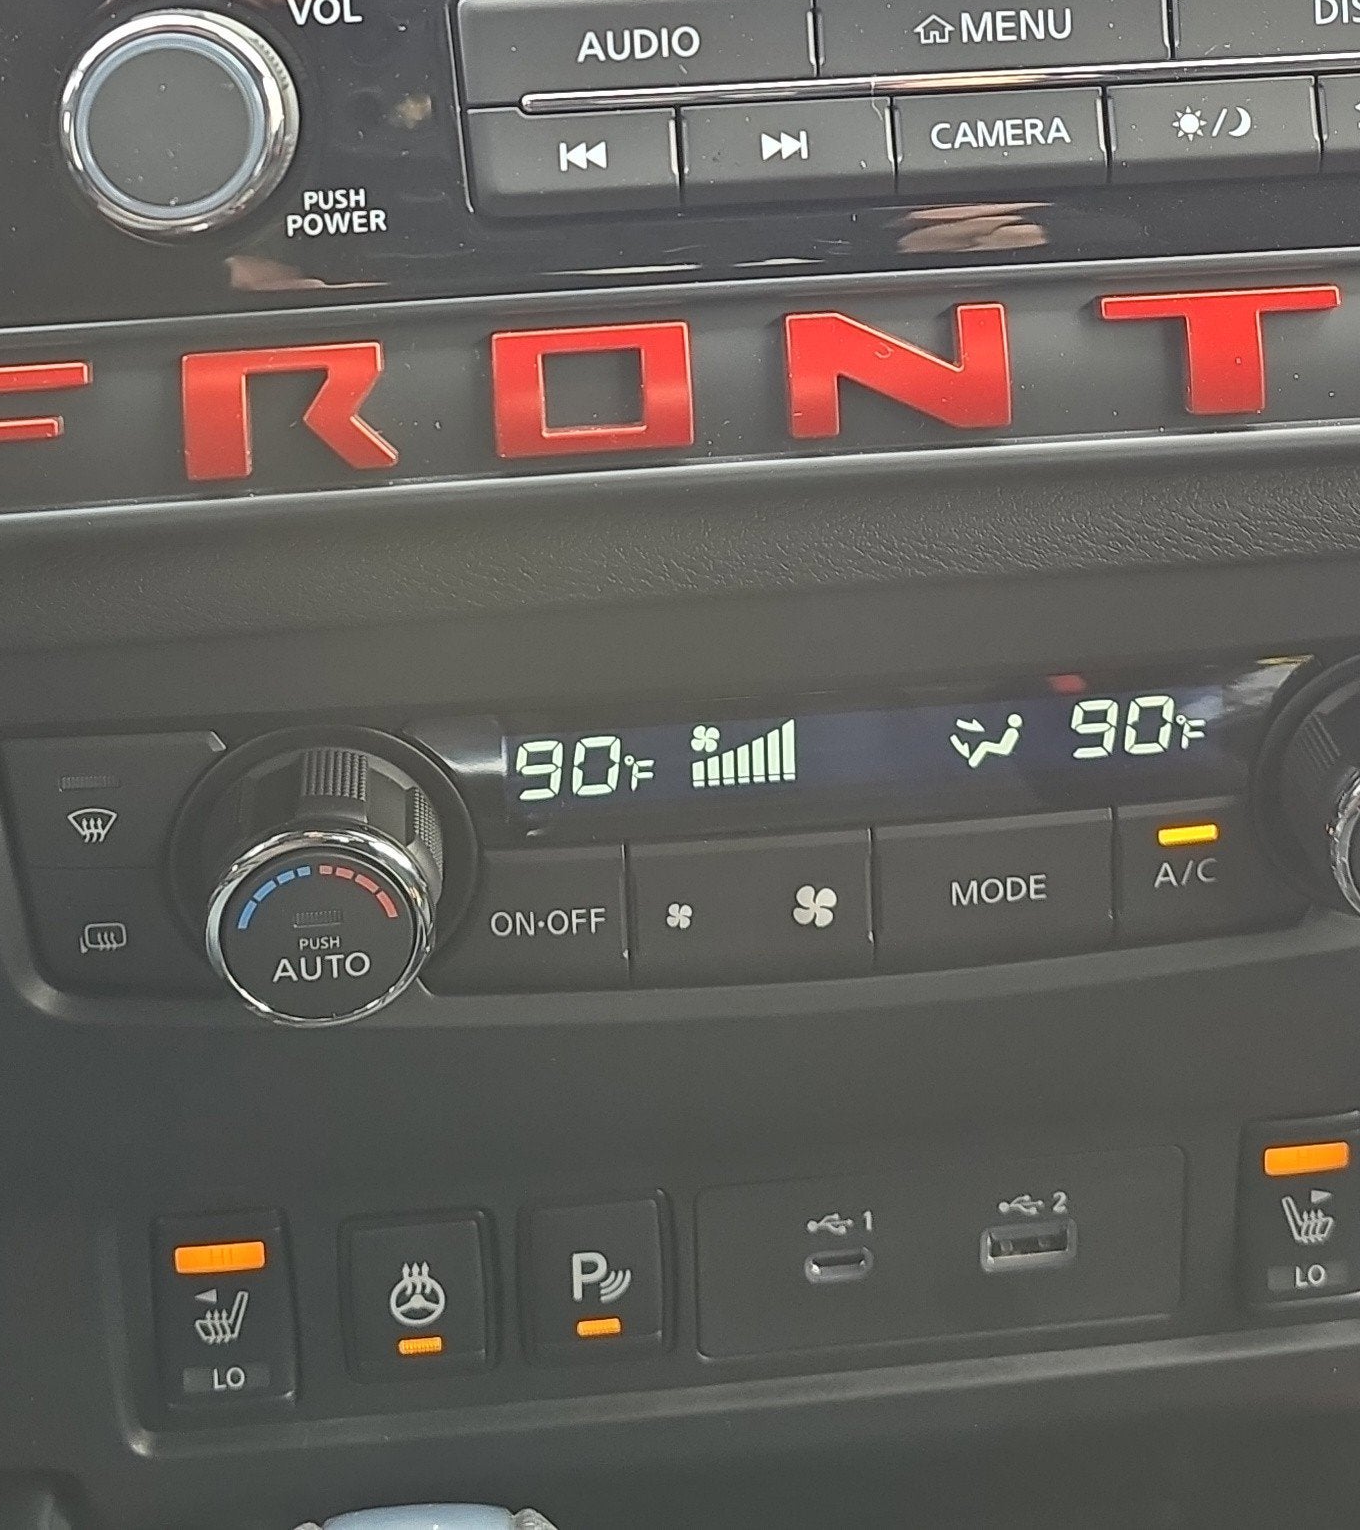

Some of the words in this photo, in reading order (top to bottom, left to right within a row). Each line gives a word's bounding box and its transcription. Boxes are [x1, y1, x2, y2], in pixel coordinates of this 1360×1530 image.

[960, 8, 1073, 44] MENU
[577, 27, 700, 63] AUDIO
[930, 118, 1071, 150] CAMERA
[303, 189, 365, 211] PUSH
[287, 209, 387, 237] POWER
[1153, 857, 1218, 889] A/C
[950, 873, 1048, 906] MODE
[298, 934, 342, 952] PUSH
[272, 952, 371, 983] AUTO
[1051, 1191, 1068, 1213] 2
[863, 1211, 874, 1230] 1
[1295, 1264, 1326, 1289] LO
[212, 1366, 245, 1391] LO
